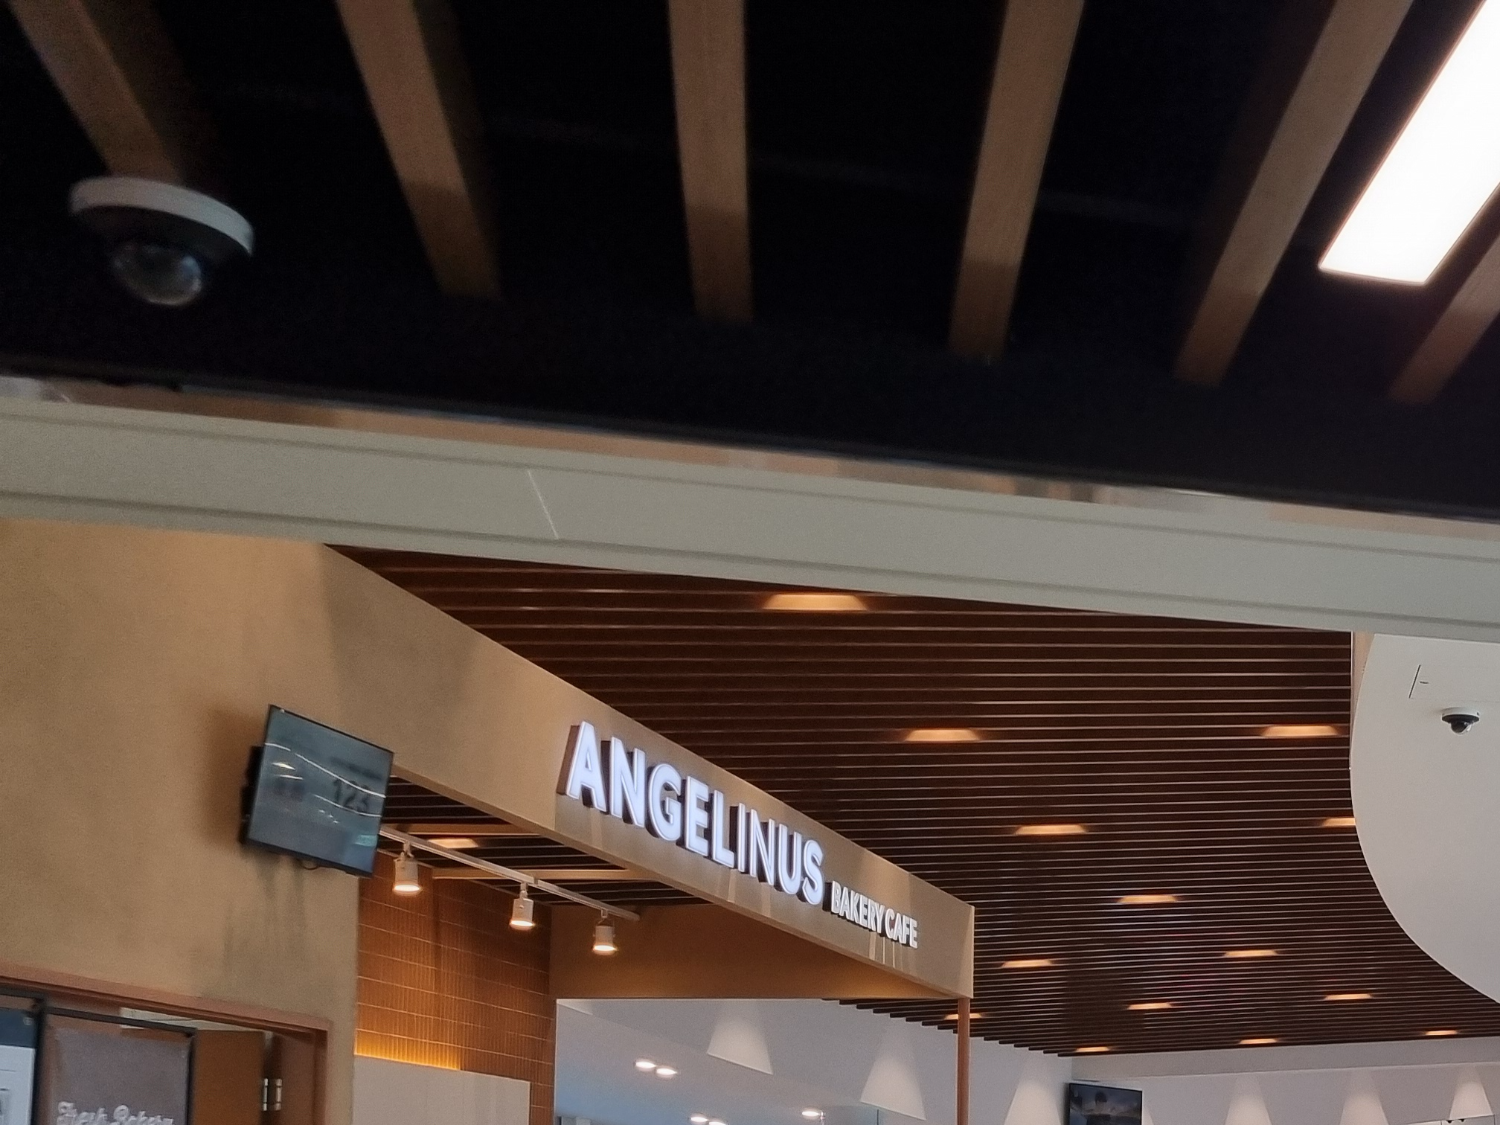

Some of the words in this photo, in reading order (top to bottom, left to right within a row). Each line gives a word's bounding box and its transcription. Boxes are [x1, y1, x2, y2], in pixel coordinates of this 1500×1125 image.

[564, 720, 826, 906] ANGELINUS
[830, 880, 885, 934] BAKERY
[884, 908, 918, 949] CAFE
